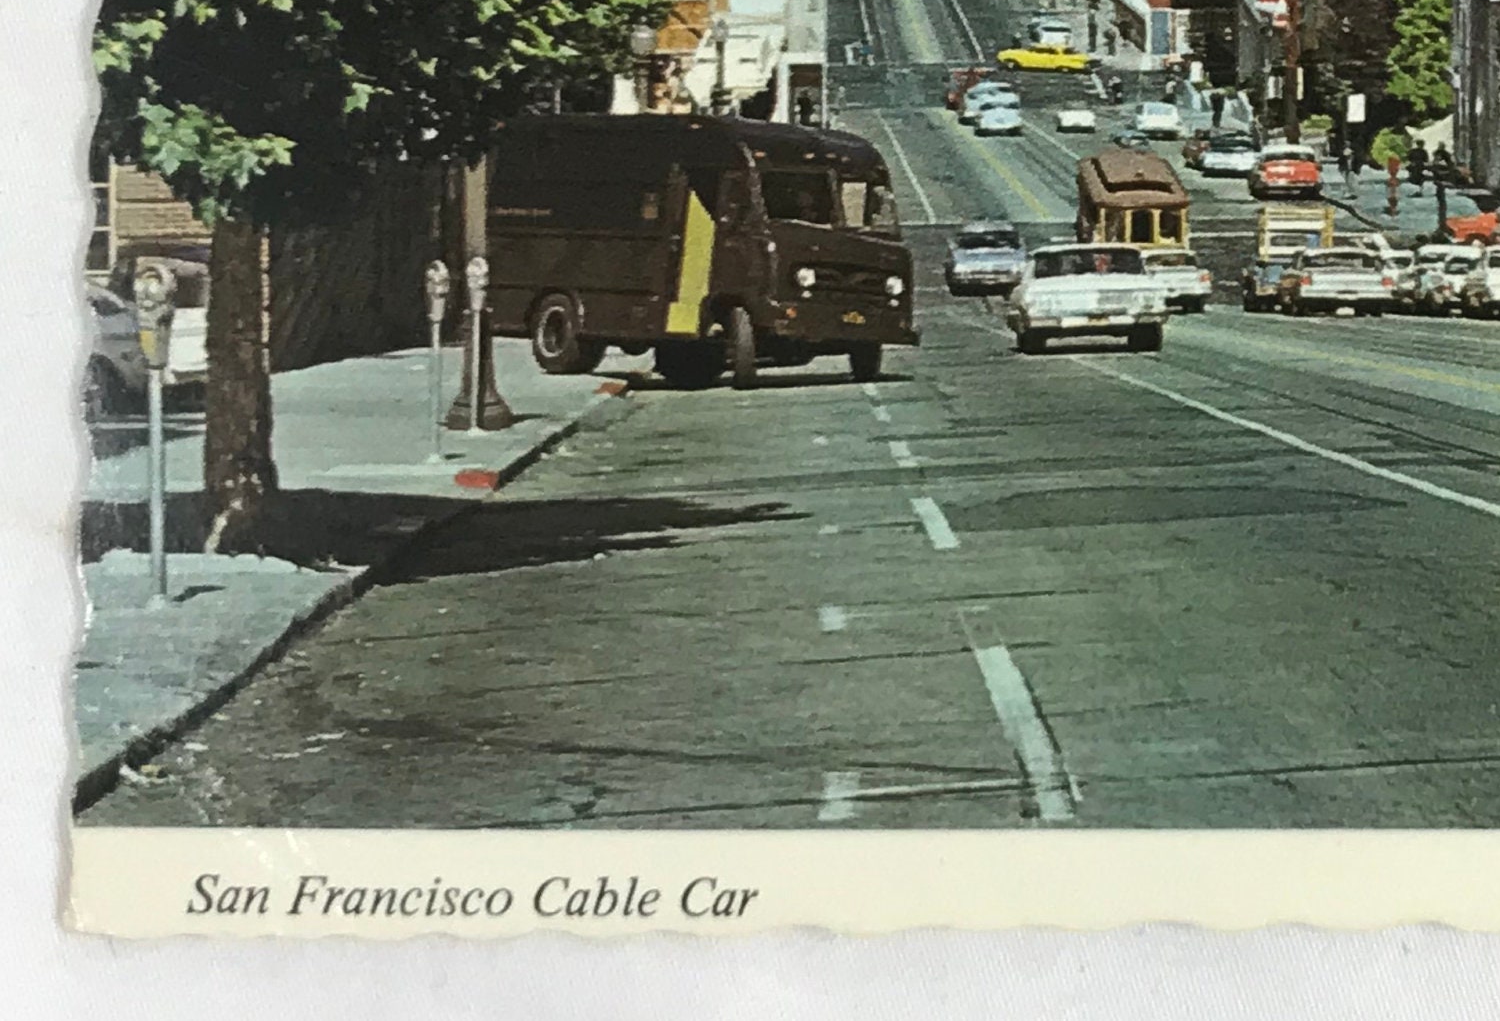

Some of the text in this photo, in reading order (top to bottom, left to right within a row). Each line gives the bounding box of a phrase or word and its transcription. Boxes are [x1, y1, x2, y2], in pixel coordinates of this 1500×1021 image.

[185, 872, 761, 917] San Francisco Cable Car
